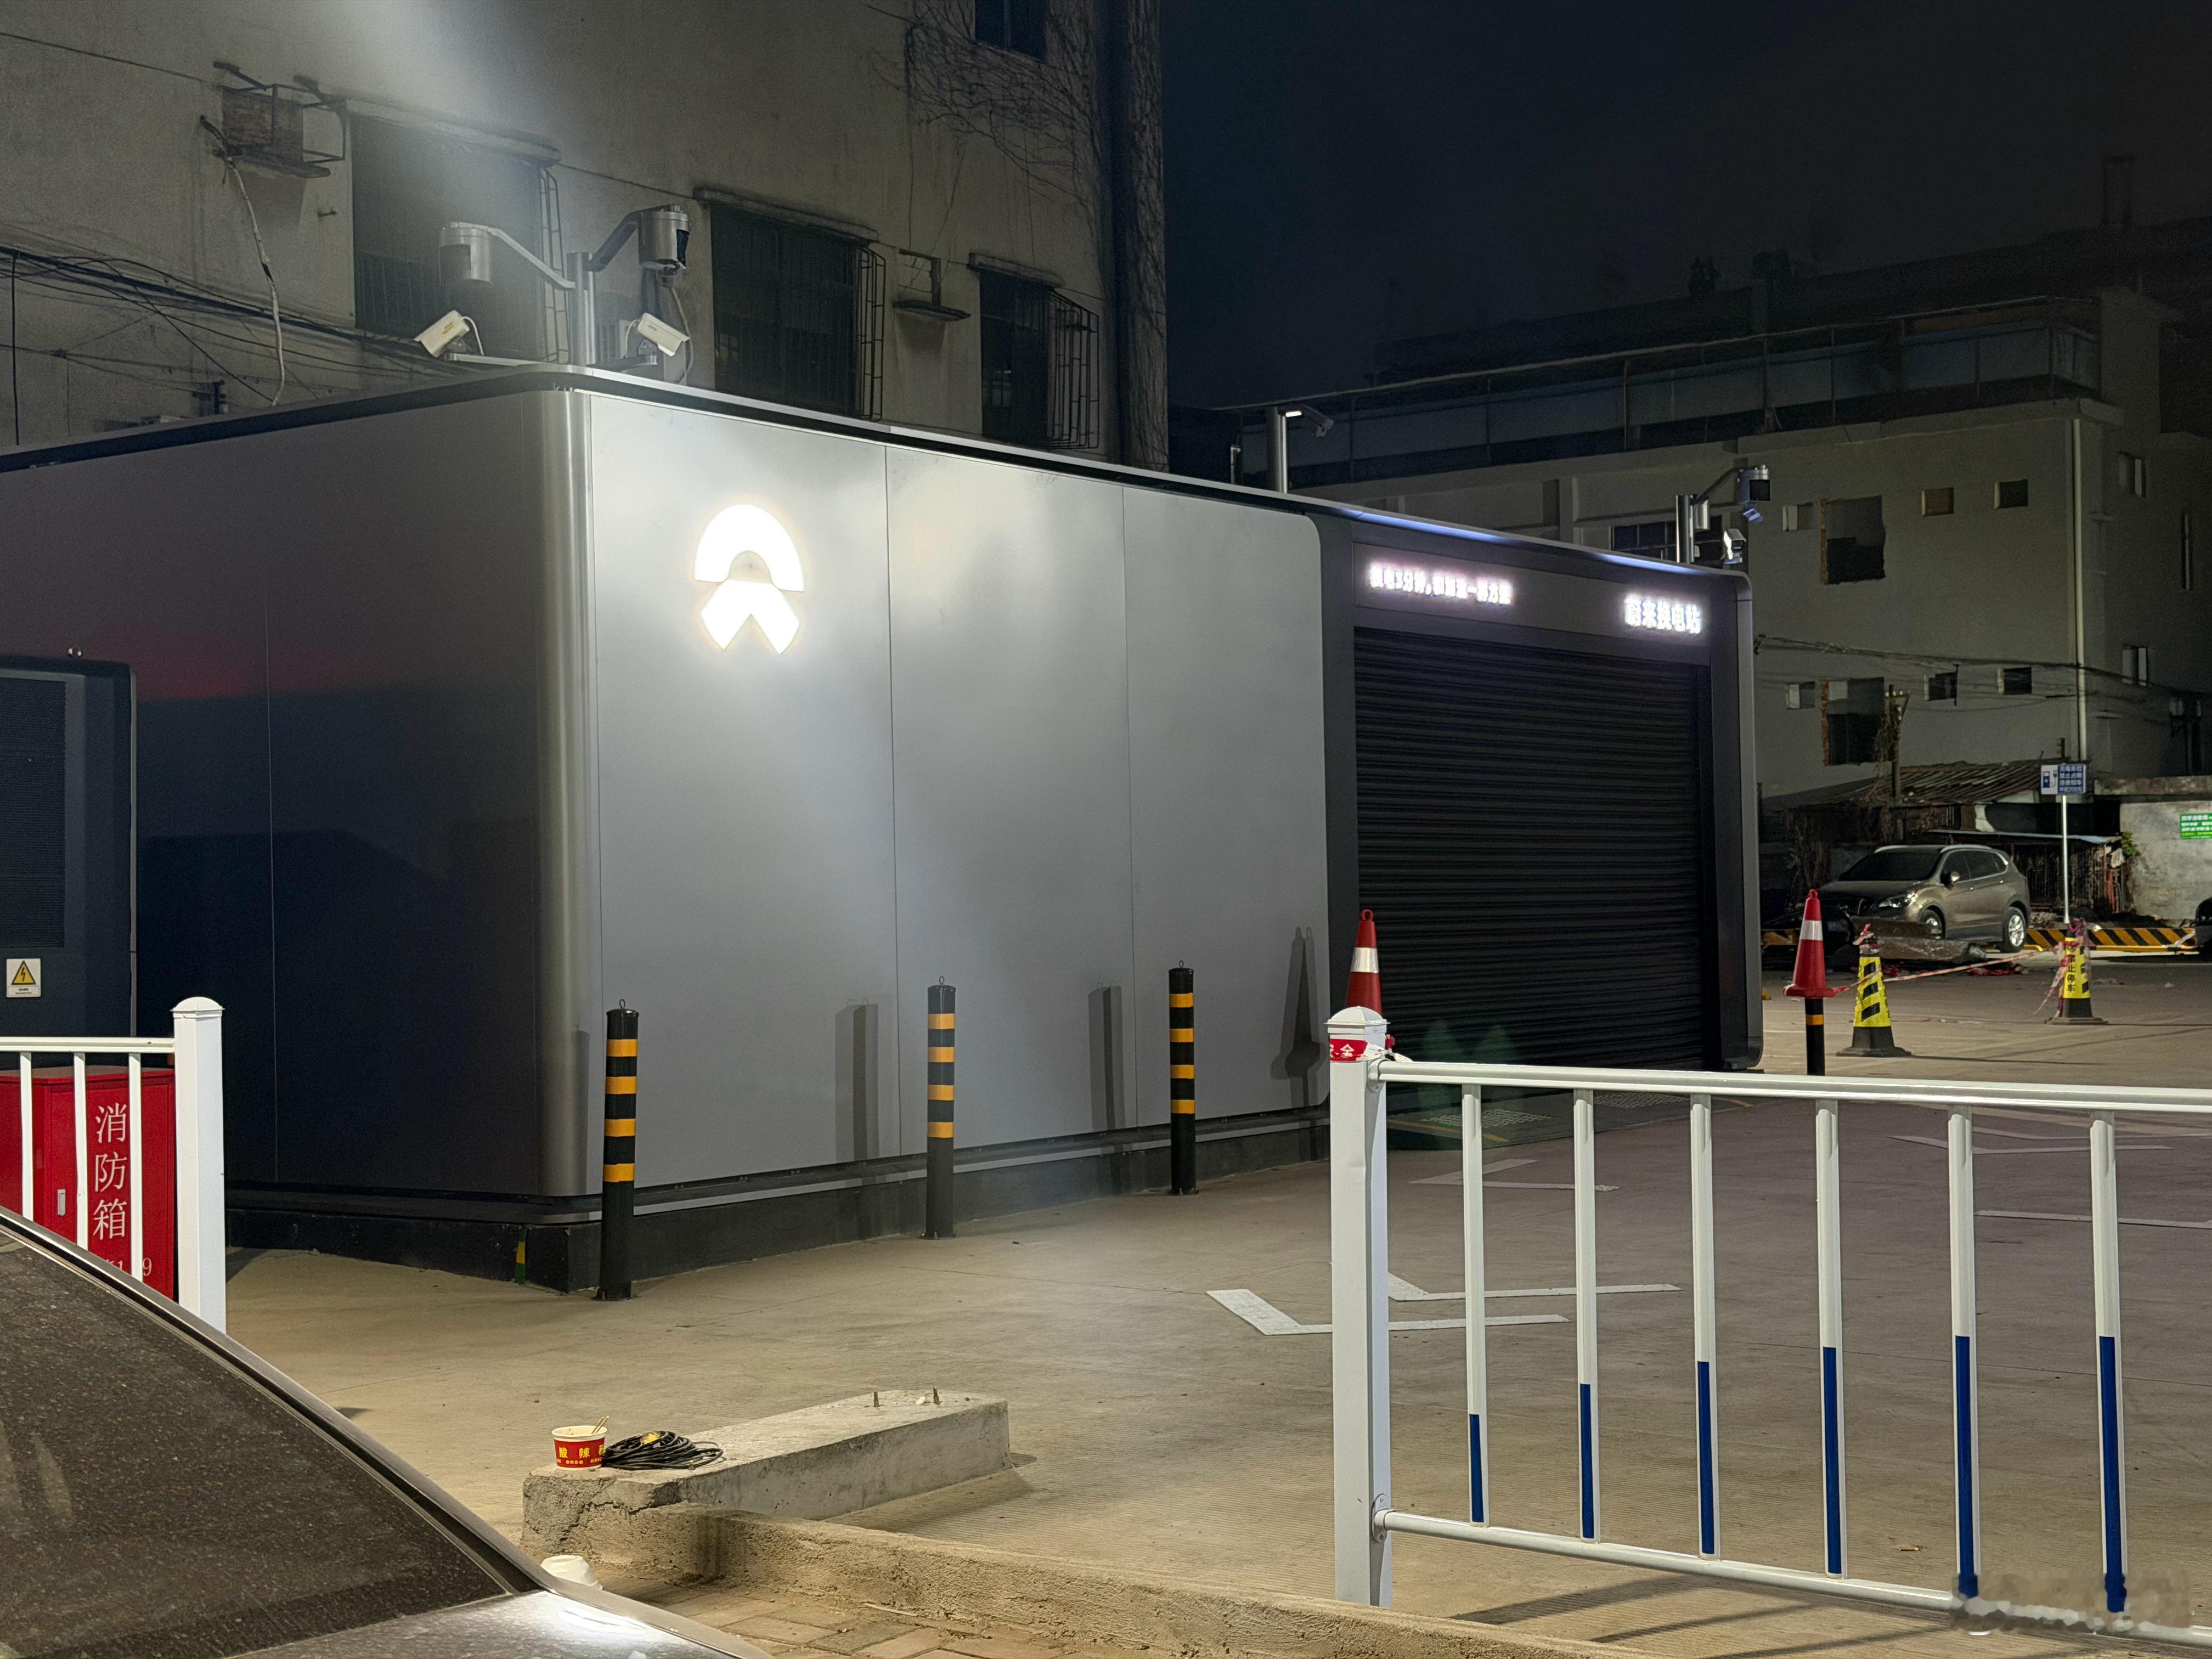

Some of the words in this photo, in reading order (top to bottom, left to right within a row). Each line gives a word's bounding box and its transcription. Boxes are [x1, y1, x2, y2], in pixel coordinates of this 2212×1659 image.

[1624, 596, 1702, 634] 蔚来换电站
[93, 1102, 127, 1240] 消防箱
